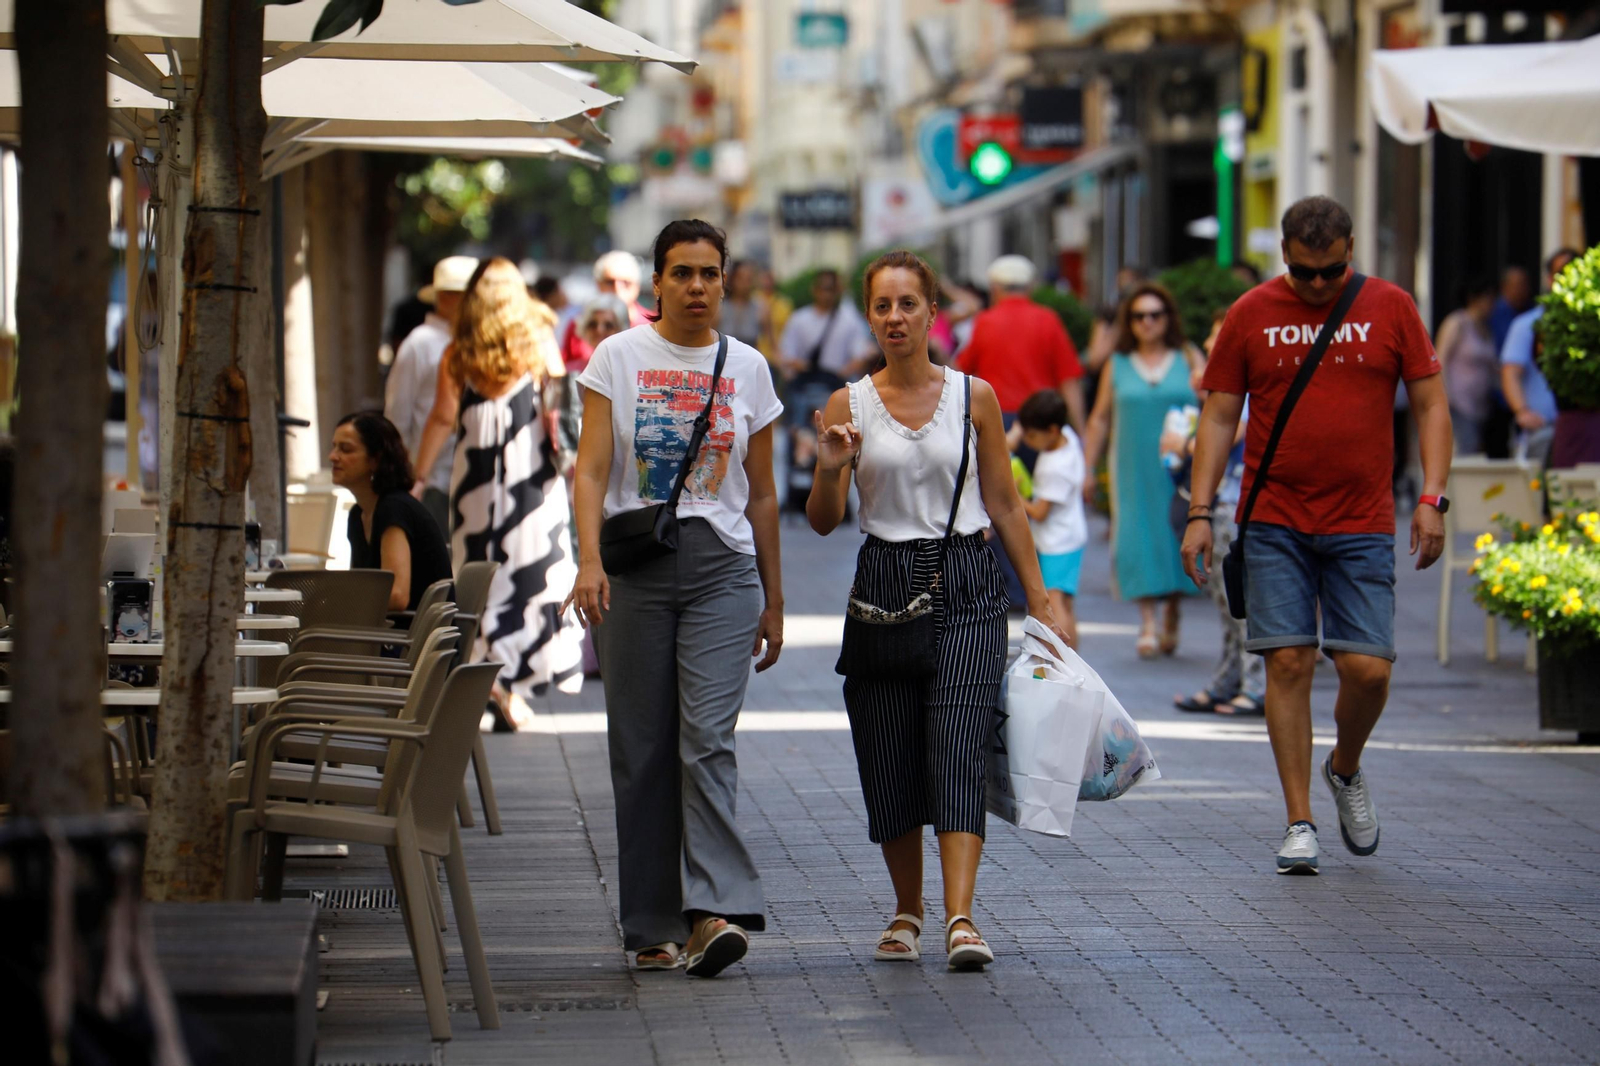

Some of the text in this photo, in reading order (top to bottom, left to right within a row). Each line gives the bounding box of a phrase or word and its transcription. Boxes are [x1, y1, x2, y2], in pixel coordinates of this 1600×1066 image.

[1263, 322, 1371, 347] TOMMY
[1277, 353, 1364, 367] JENS
[637, 370, 736, 394] FRENCH RIVIRA
